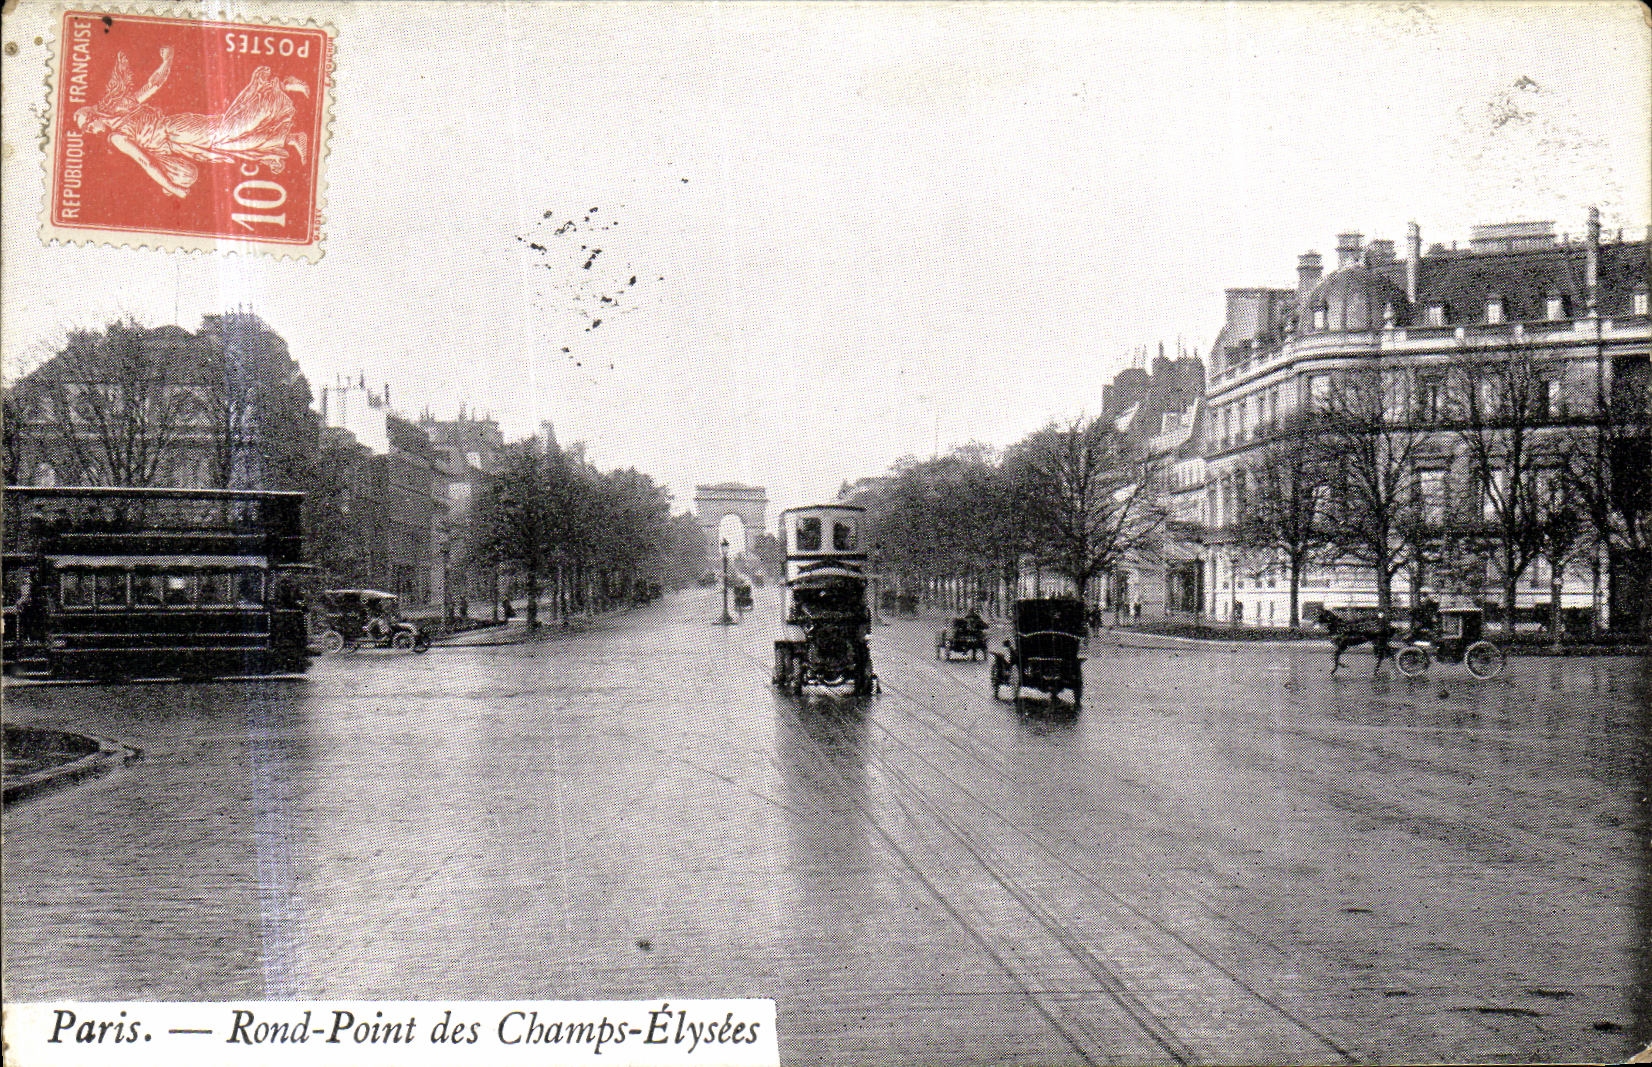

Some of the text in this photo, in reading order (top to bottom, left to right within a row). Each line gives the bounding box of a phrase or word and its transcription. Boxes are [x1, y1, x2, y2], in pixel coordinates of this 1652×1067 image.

[225, 33, 309, 58] POSTES
[62, 22, 91, 218] REPUBLIQUE FRANÇAISE
